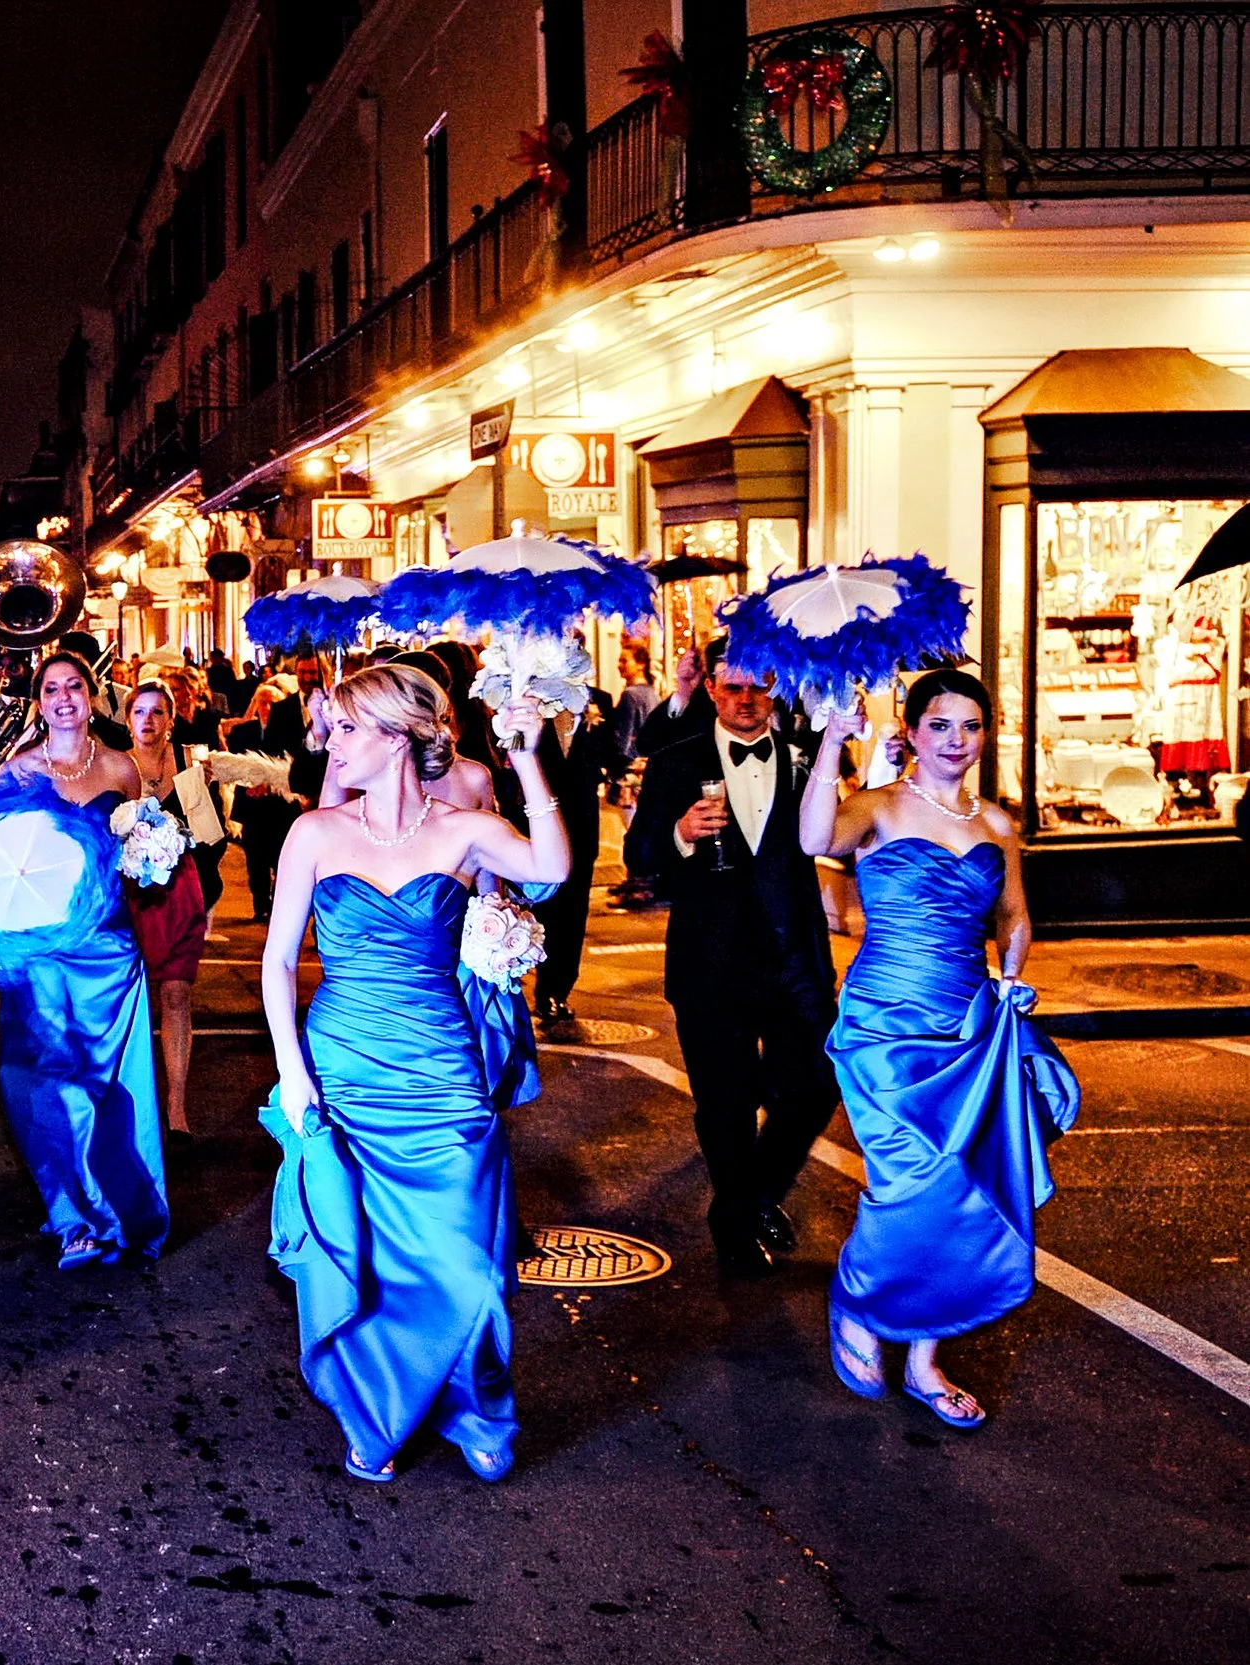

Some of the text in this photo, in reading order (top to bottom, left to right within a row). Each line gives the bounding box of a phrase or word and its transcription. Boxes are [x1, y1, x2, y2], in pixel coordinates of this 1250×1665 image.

[473, 418, 503, 445] ONE WAY
[551, 492, 618, 513] ROYALE
[317, 541, 395, 557] ROUX ROYALE
